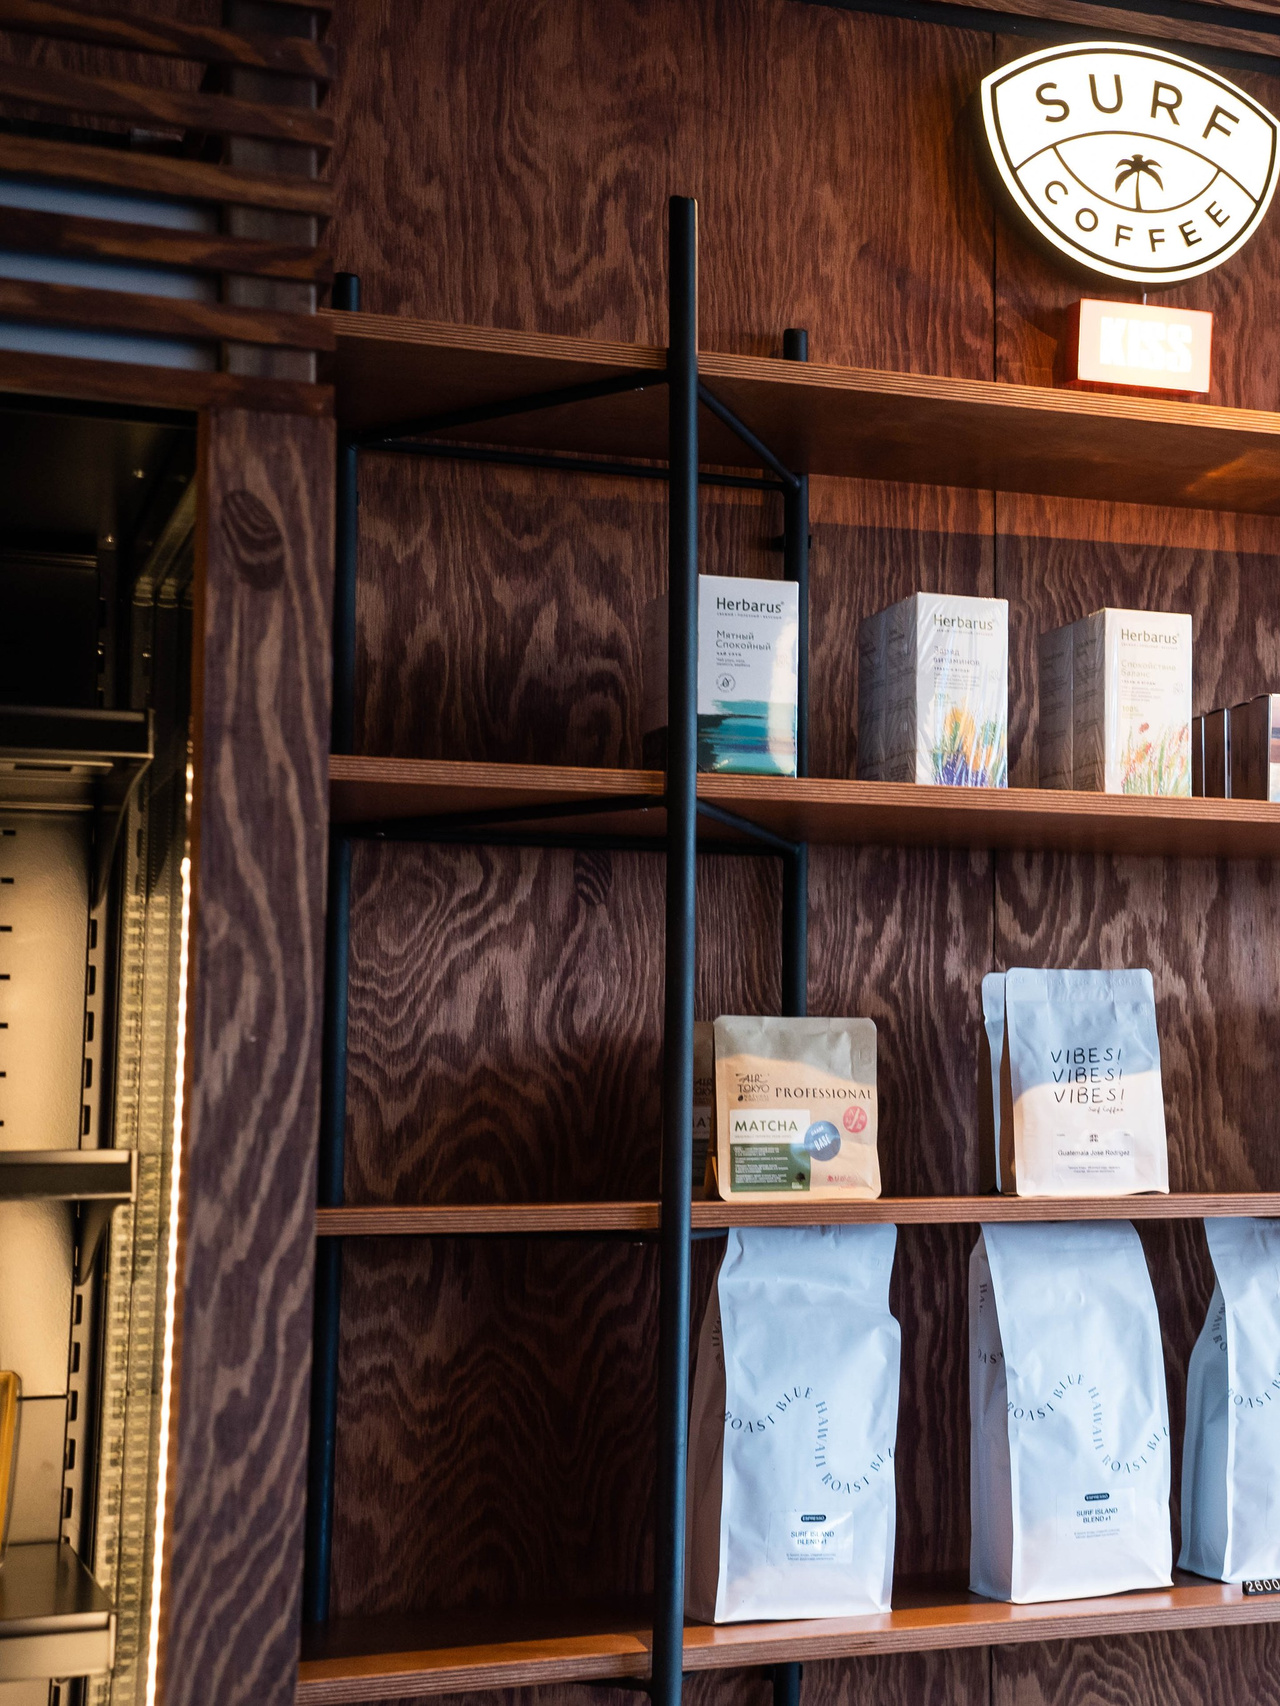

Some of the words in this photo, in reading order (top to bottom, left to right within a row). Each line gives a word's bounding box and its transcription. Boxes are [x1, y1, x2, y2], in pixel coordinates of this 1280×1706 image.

[1035, 74, 1240, 139] SURF
[1044, 180, 1231, 253] COFFEE
[1099, 316, 1193, 373] KISS
[716, 596, 783, 614] Herbarus
[933, 613, 994, 631] Herbarus
[716, 630, 755, 641] Мятный
[1121, 628, 1178, 645] Herbarus
[715, 639, 772, 651] Спокойный
[1051, 1047, 1122, 1065] VIBES!
[1052, 1067, 1123, 1085] VIBES!
[737, 1084, 770, 1094] TOKYO
[775, 1087, 873, 1100] PROFESSIONAL
[1054, 1086, 1125, 1105] VIBES!
[735, 1120, 798, 1131] MATCHA
[775, 1386, 814, 1412] BLUE
[1053, 1374, 1085, 1399] BLUE
[1088, 1386, 1104, 1450] HAWAII
[1102, 1454, 1148, 1474] ROAST
[814, 1401, 829, 1468] HAWAII
[821, 1472, 870, 1495] ROAST
[1076, 1509, 1093, 1517] SURF
[1094, 1507, 1118, 1515] ISLAND
